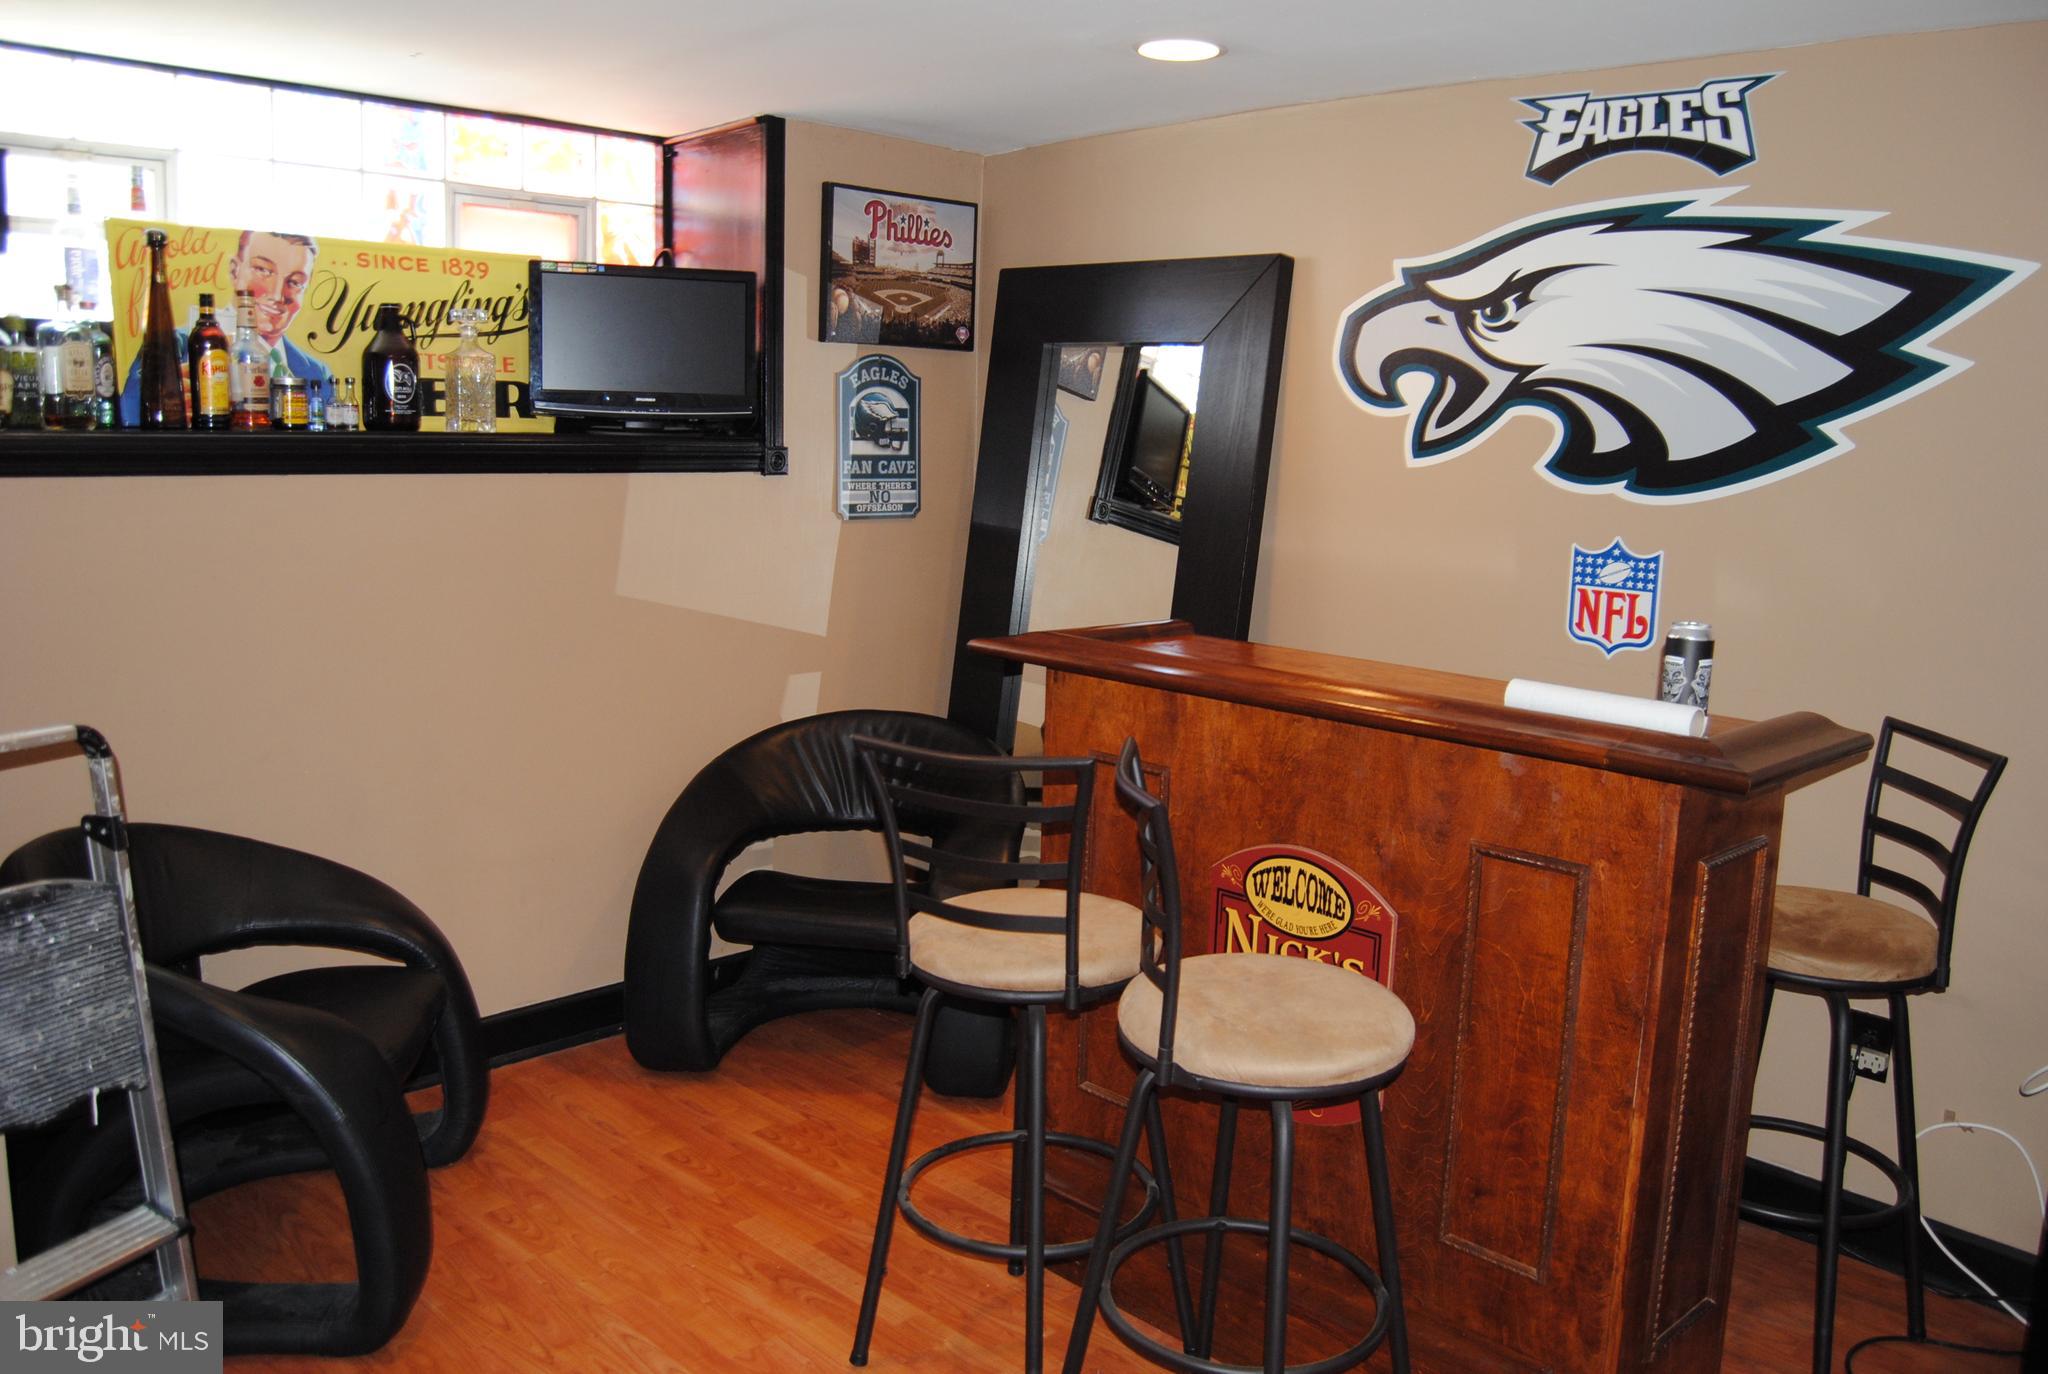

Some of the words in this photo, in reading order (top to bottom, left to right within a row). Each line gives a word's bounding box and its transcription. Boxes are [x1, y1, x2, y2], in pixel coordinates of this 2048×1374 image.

[1515, 75, 1765, 174] EAGLES
[864, 199, 953, 249] Phillies
[356, 252, 430, 273] SINCE
[442, 258, 490, 280] 1829
[307, 269, 530, 355] Yungling's
[849, 366, 909, 390] EAGLES
[843, 460, 872, 474] FAN
[878, 460, 916, 475] CAVE
[847, 482, 878, 490] WHERE
[868, 490, 891, 504] NO
[856, 503, 903, 512] OFFSEASON
[1575, 588, 1649, 644] NFL
[1252, 865, 1345, 921] WELCOME
[1275, 915, 1294, 932] GLAD
[1319, 920, 1338, 935] HERE
